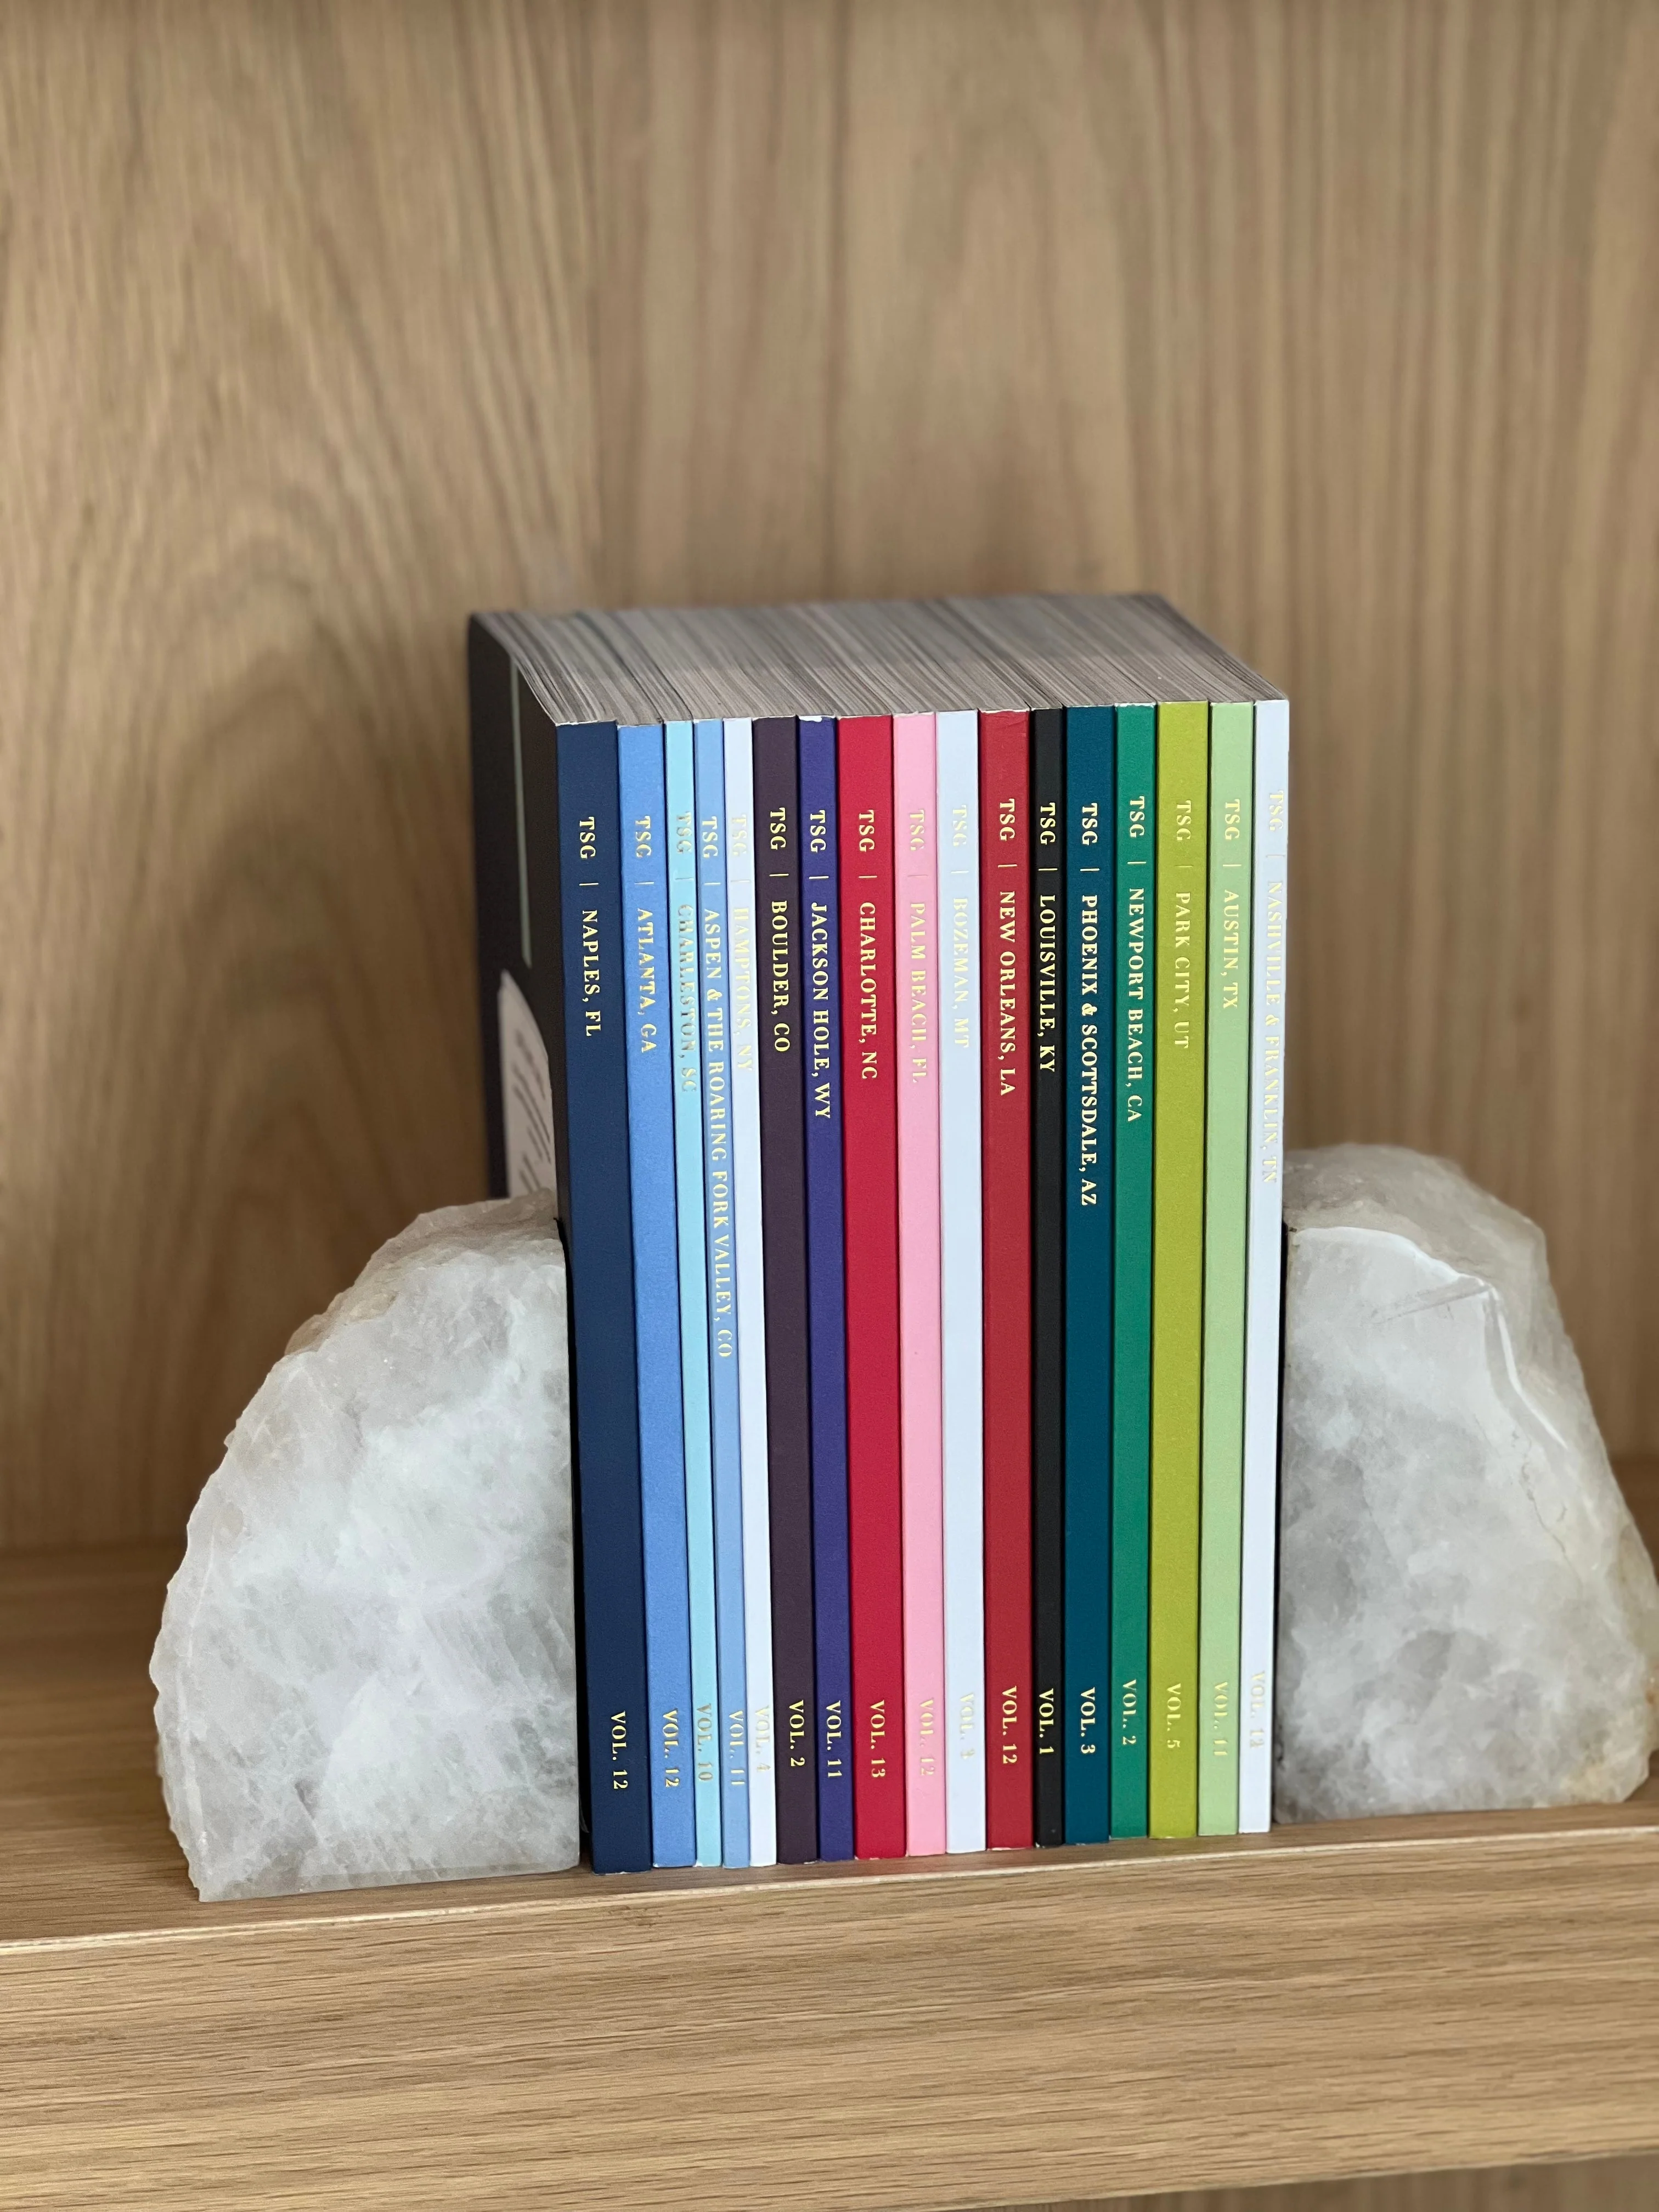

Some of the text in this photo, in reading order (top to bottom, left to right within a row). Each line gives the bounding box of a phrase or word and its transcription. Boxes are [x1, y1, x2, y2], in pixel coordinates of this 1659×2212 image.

[579, 816, 601, 1036] TSG NAPLES, FL
[635, 816, 657, 1053] TSG ATLANTA, GA
[770, 808, 790, 1052] TSG BOULDER, CO
[859, 809, 878, 1079] TSG CHARLOTTE, NC
[952, 805, 969, 1048] TSG BOZEMAN, MT
[1039, 803, 1056, 1072] TSG LOUISVILLE, KY
[1173, 800, 1192, 1049] TSG PARK CITY, UT
[1222, 799, 1240, 1009] TSG AUSTIN, TX
[676, 812, 697, 1092] TSG CHARLESTON, SC
[810, 810, 831, 1118] TSG JACKSON HOLE, WY
[909, 810, 927, 1082] TSG PALM BEACH, FL
[999, 798, 1016, 1096] TSG NEW ORLEANS, LA
[1126, 796, 1145, 1122] TSG NEWPORT BEACH, CA
[1080, 803, 1098, 1205] TSG PHOENIX & SCOTTSDALE, AZ
[1266, 1014, 1279, 1027] &
[702, 816, 732, 1357] TSG ASPEN & THE ROARING FORK VALLEY, CO
[611, 1711, 628, 1790] VOL. 12
[663, 1709, 680, 1788] VOL. 12
[697, 1703, 712, 1752] VOL.
[729, 1711, 745, 1786] VOL. 11
[789, 1700, 805, 1767] VOL. 2
[826, 1701, 843, 1778] VOL. 11
[870, 1700, 886, 1778] VOL. 13
[919, 1699, 934, 1746] VOL.
[960, 1692, 974, 1740] VOL.
[1002, 1685, 1018, 1765] VOL. 12
[1039, 1689, 1054, 1755] VOL. 1
[1081, 1687, 1096, 1755] VOL. 3
[1122, 1679, 1137, 1746] VOL. 2
[1167, 1683, 1182, 1749] VOL. 5
[1213, 1681, 1228, 1757] VOL. 11
